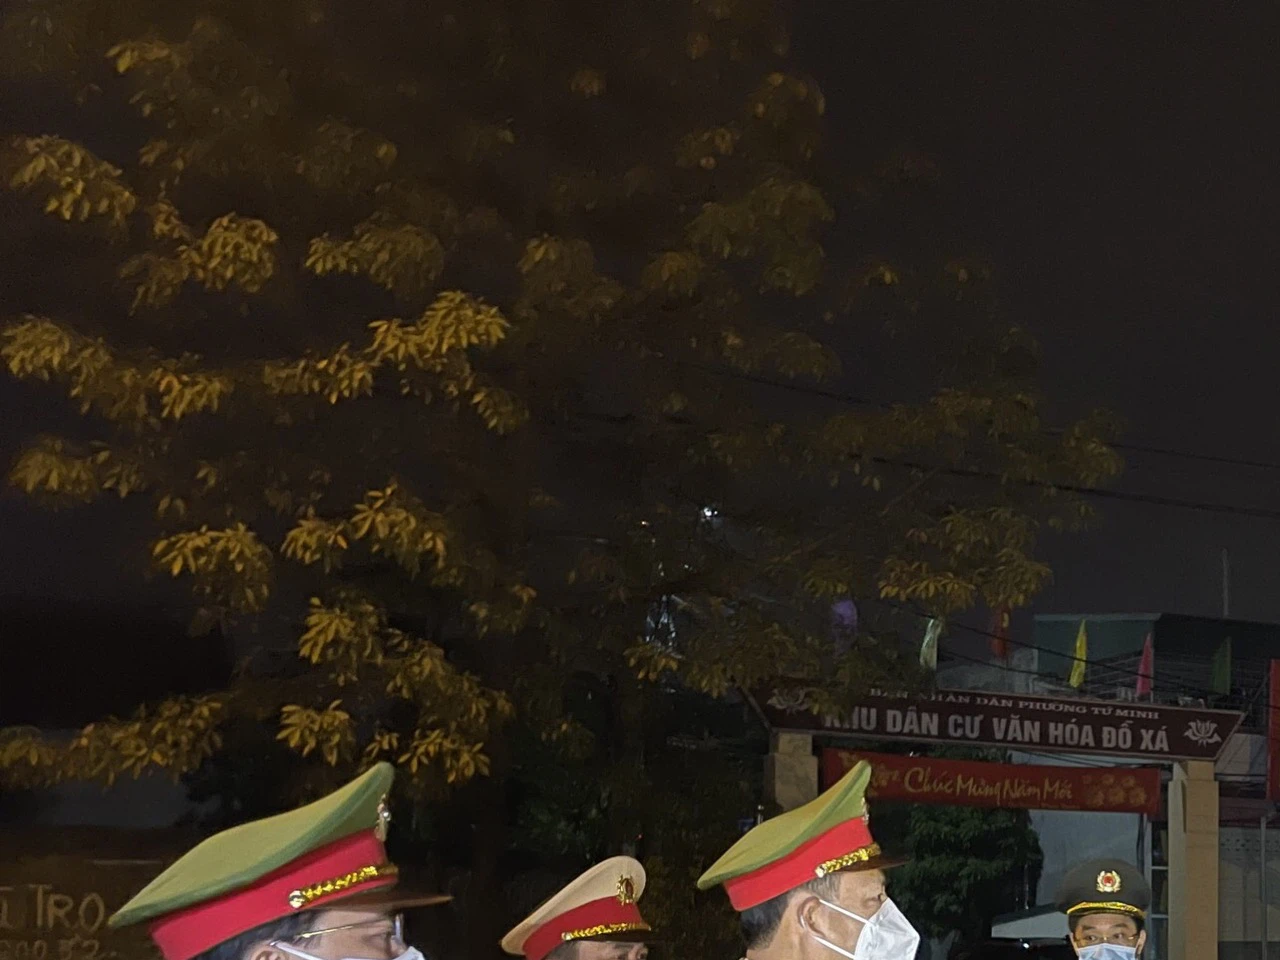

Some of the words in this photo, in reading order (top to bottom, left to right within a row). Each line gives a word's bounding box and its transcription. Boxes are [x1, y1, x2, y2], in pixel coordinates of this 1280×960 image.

[975, 694, 1013, 708] DÂN
[1114, 708, 1160, 720] MINH
[886, 705, 939, 736] DÂN
[948, 713, 985, 739] CƯ
[992, 713, 1041, 743] VĂN
[1048, 718, 1096, 747] HÓA
[1101, 719, 1135, 750] ĐỖ
[1139, 725, 1170, 752] XÁ
[903, 765, 954, 794] Chúc
[1003, 778, 1041, 801] Năm
[1043, 776, 1073, 801] Mới
